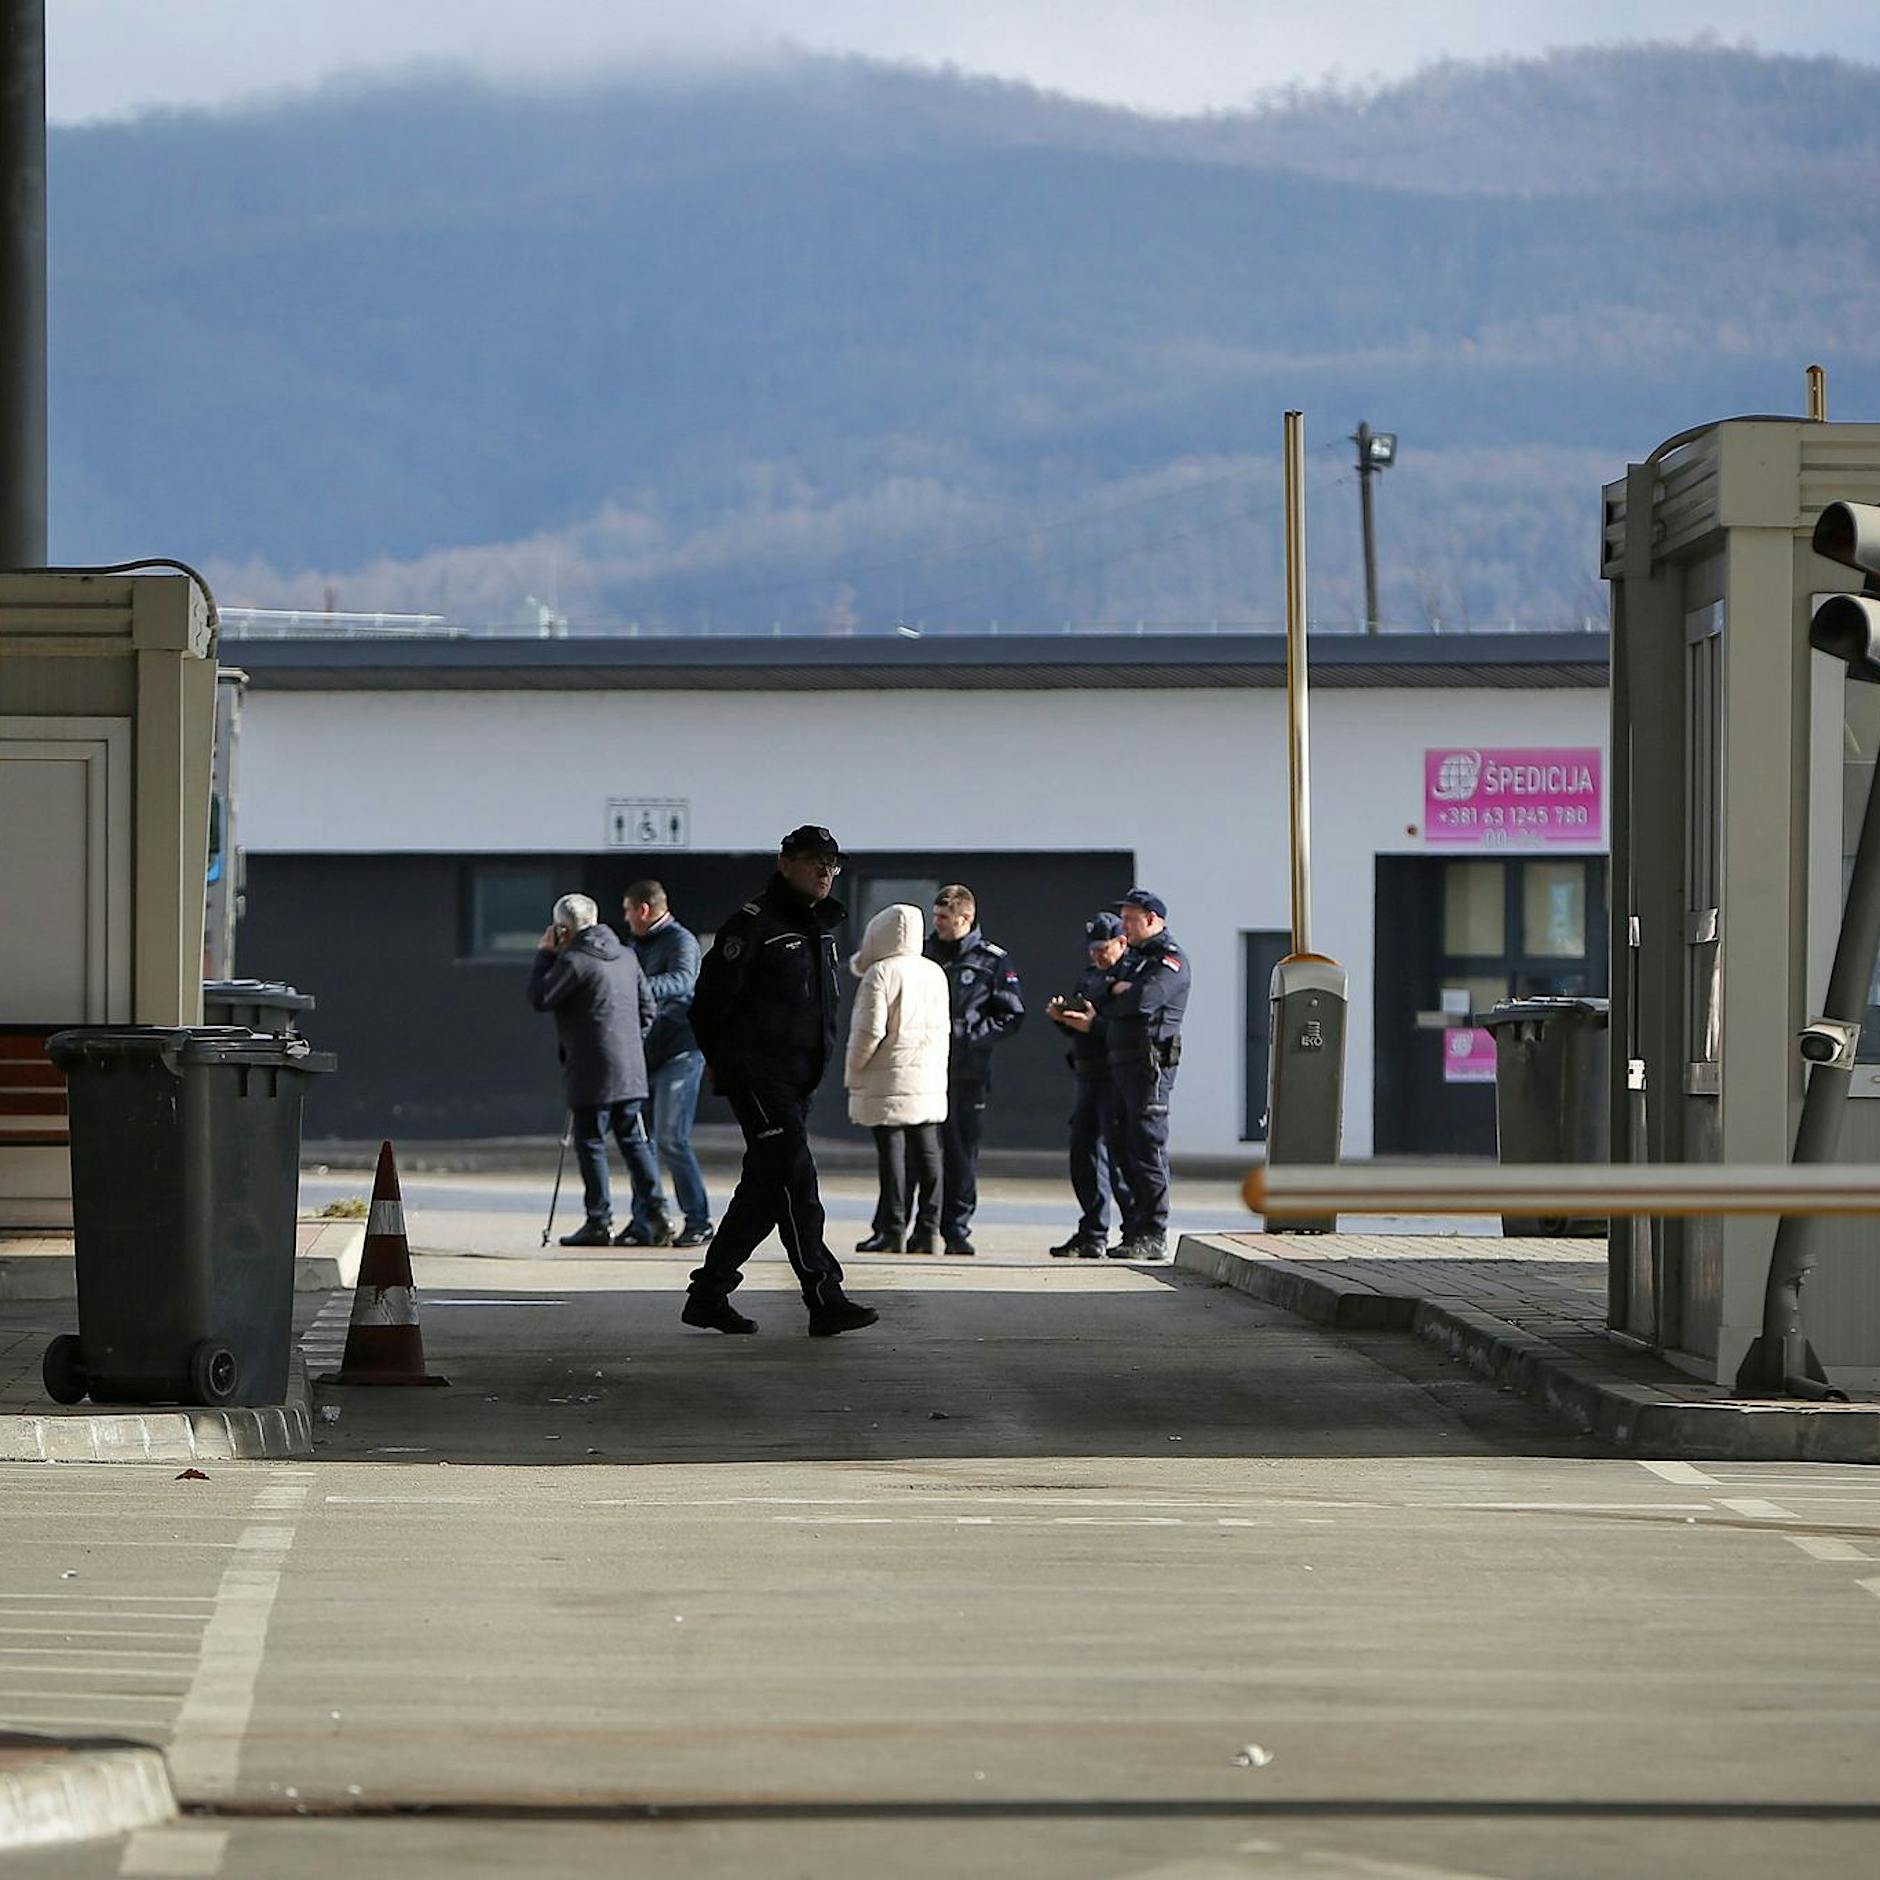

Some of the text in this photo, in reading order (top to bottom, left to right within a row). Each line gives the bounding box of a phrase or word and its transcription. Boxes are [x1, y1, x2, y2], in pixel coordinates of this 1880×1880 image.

[1485, 760, 1594, 794] ŠPEDICIJA
[1439, 806, 1588, 825] +381 63 1245 780
